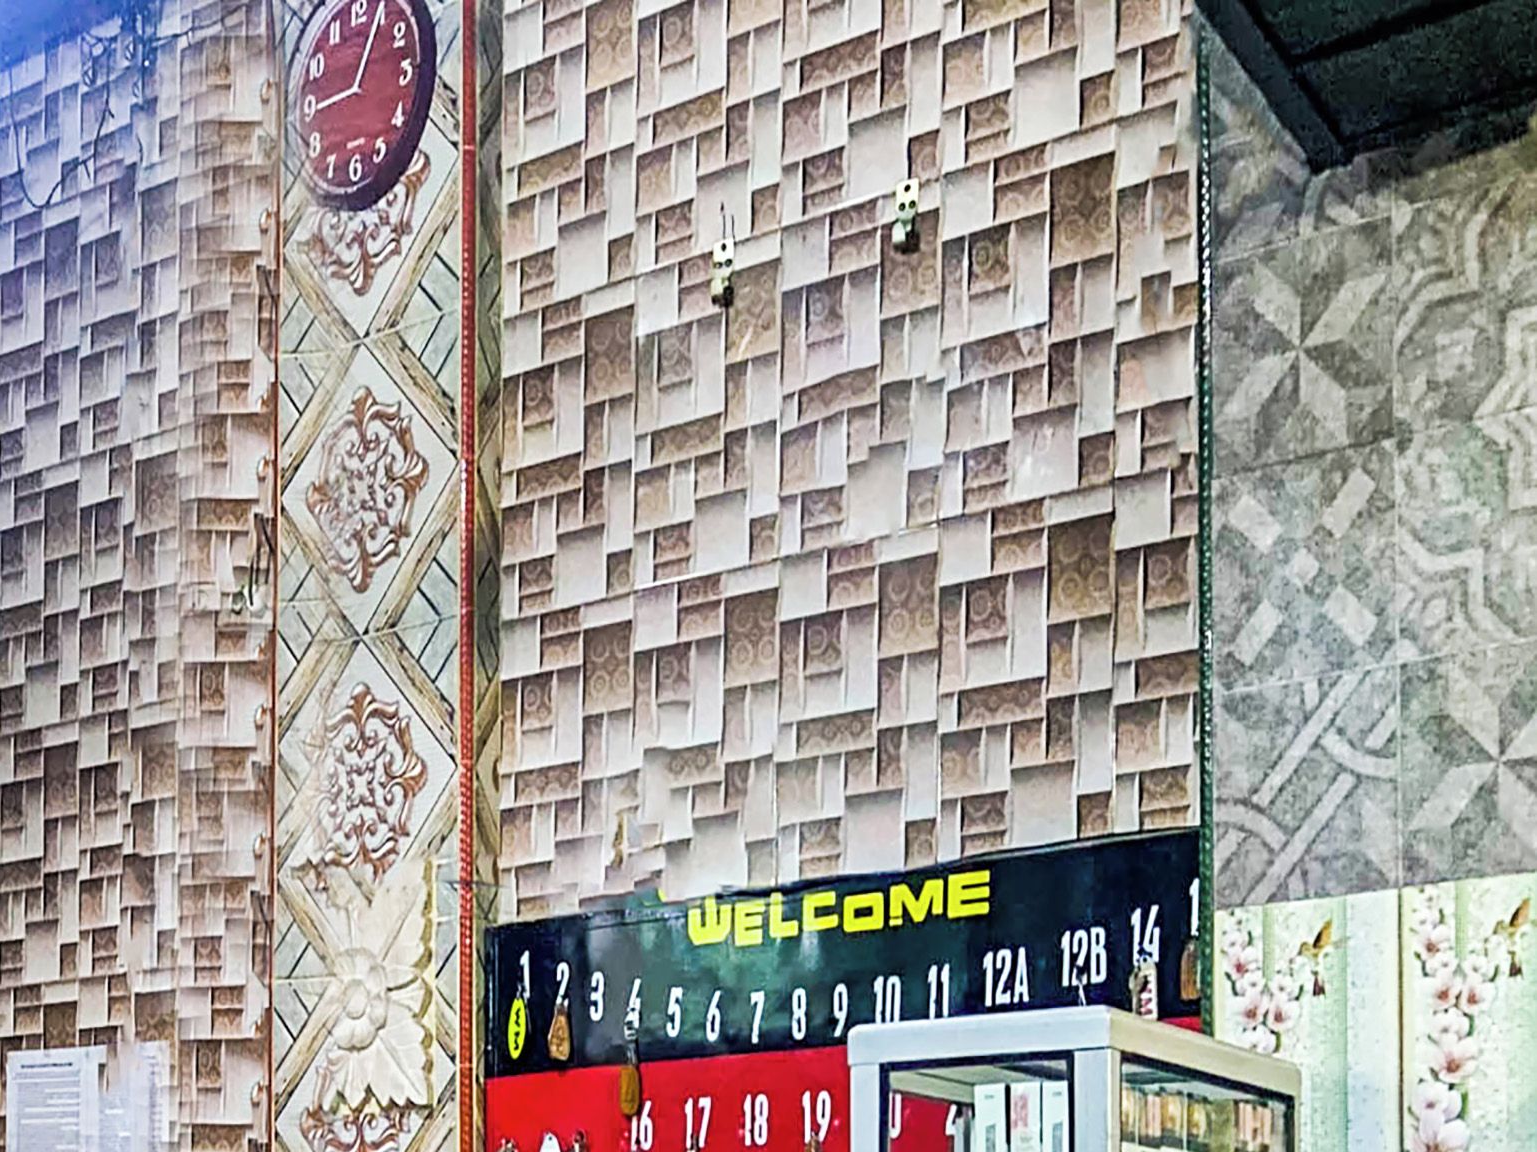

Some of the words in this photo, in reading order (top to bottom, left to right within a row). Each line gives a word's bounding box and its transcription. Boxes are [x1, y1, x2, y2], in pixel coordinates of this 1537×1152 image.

[351, 0, 367, 27] 12
[329, 19, 340, 46] 11
[393, 21, 406, 48] 2
[309, 53, 325, 81] 10
[399, 58, 413, 86] 3
[304, 94, 316, 123] 9
[391, 101, 405, 128] 4
[309, 132, 321, 158] 8
[372, 137, 387, 164] 5
[326, 153, 337, 180] 7
[349, 154, 362, 182] 6
[686, 869, 991, 947] WELCOME
[519, 950, 531, 999] 1
[555, 961, 570, 1007] 2
[589, 971, 605, 1022] 3
[666, 986, 684, 1037] 5
[706, 990, 721, 1042] 6
[750, 990, 765, 1045] 7
[791, 987, 807, 1041] 8
[833, 983, 849, 1038] 9
[873, 975, 902, 1023] 10
[927, 963, 951, 1019] 11
[982, 946, 1030, 1007] 12A
[1060, 926, 1108, 987] 12B
[1130, 904, 1161, 968] 14
[630, 1100, 654, 1151] 16
[684, 1096, 712, 1148] 17
[743, 1093, 770, 1147] 18
[802, 1090, 832, 1144] 19
